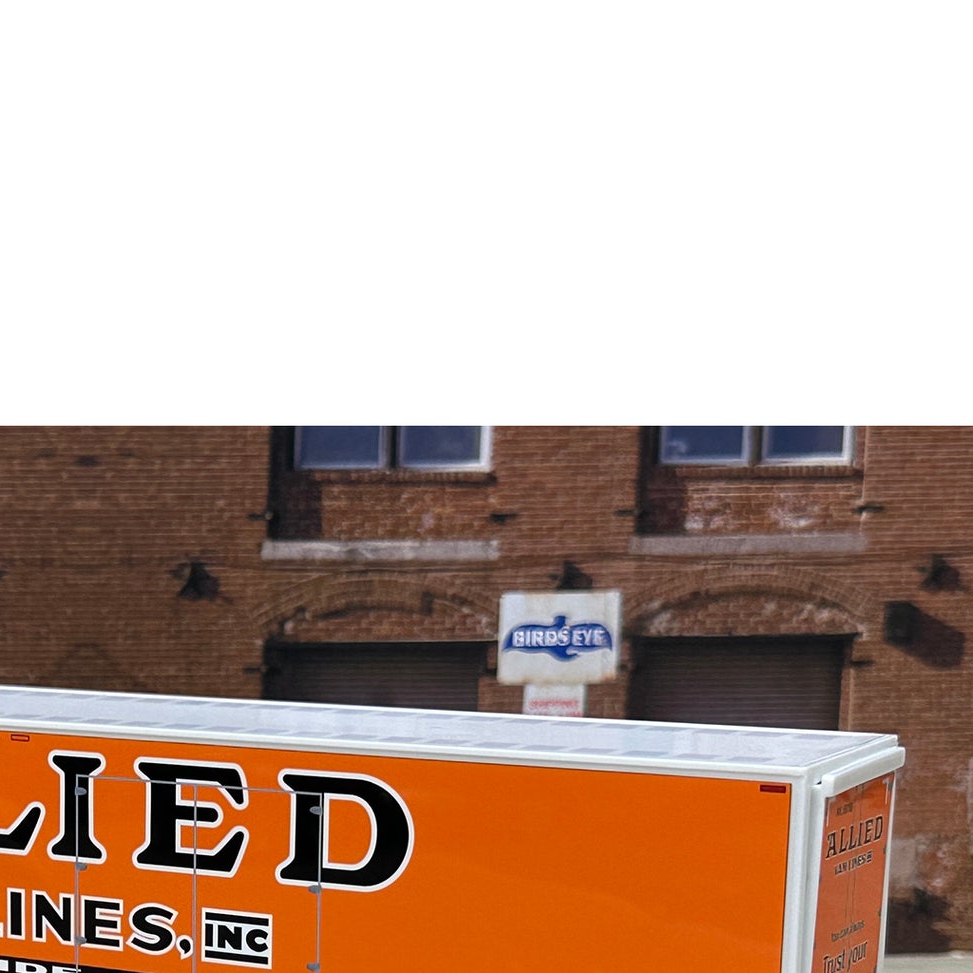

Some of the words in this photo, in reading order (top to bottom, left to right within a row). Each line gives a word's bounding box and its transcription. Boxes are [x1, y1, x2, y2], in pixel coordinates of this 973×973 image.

[572, 629, 606, 647] EYE
[825, 815, 884, 860] ALLIED
[203, 914, 271, 962] INC
[847, 941, 868, 972] your
